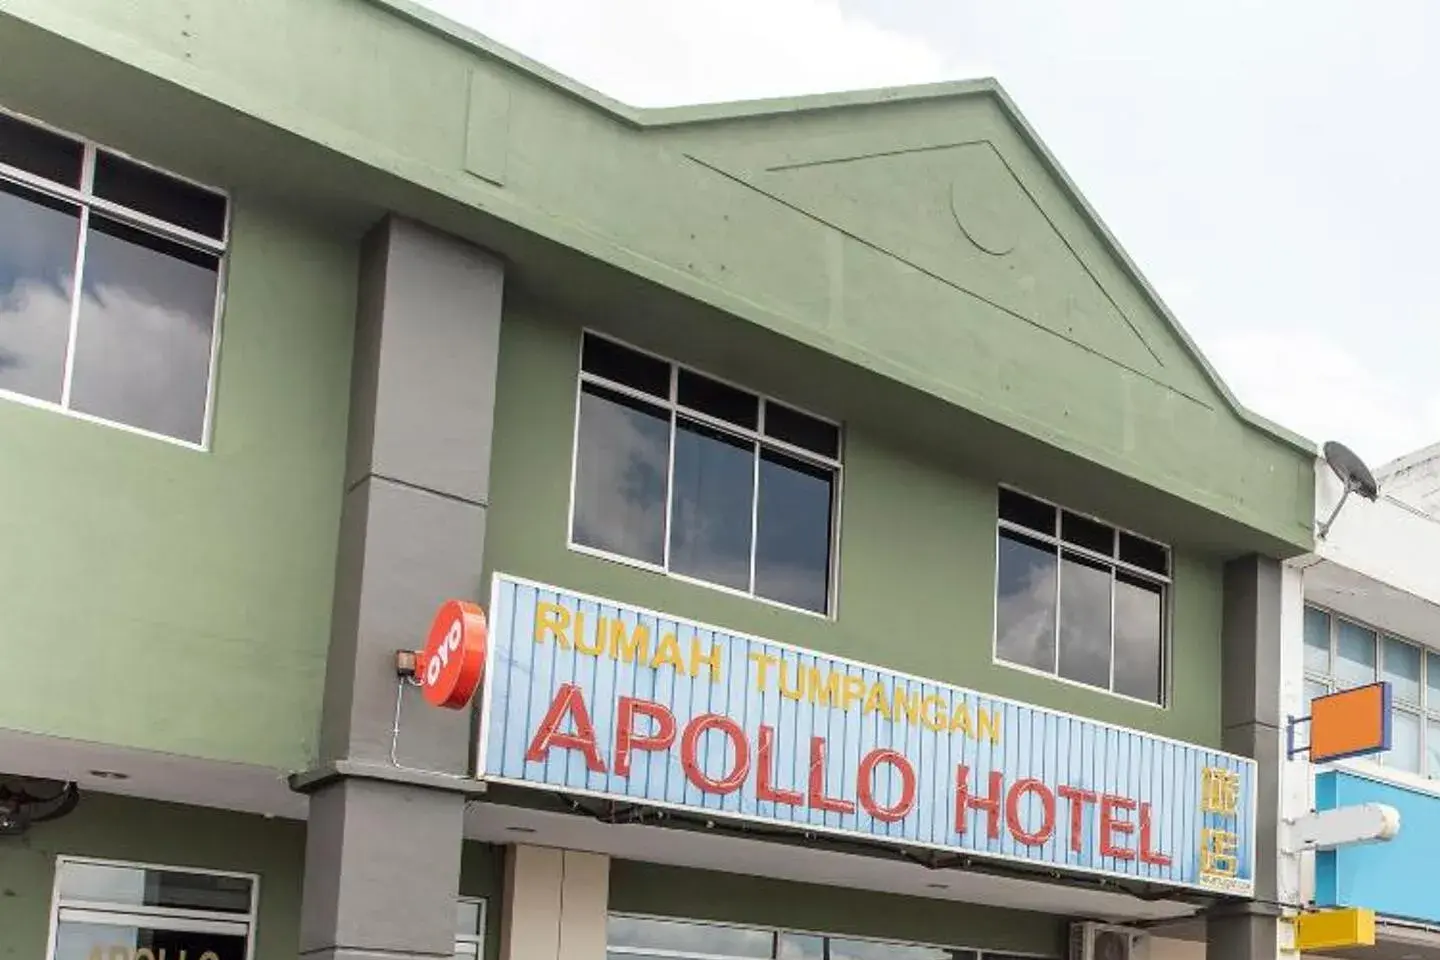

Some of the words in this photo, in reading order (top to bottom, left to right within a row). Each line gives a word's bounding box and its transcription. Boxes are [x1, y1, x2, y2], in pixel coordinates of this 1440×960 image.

[535, 601, 723, 684] RUMAH
[749, 651, 1001, 745] TUMPANGAN
[525, 682, 916, 823] APOLLO
[955, 763, 1172, 867] HOTEL
